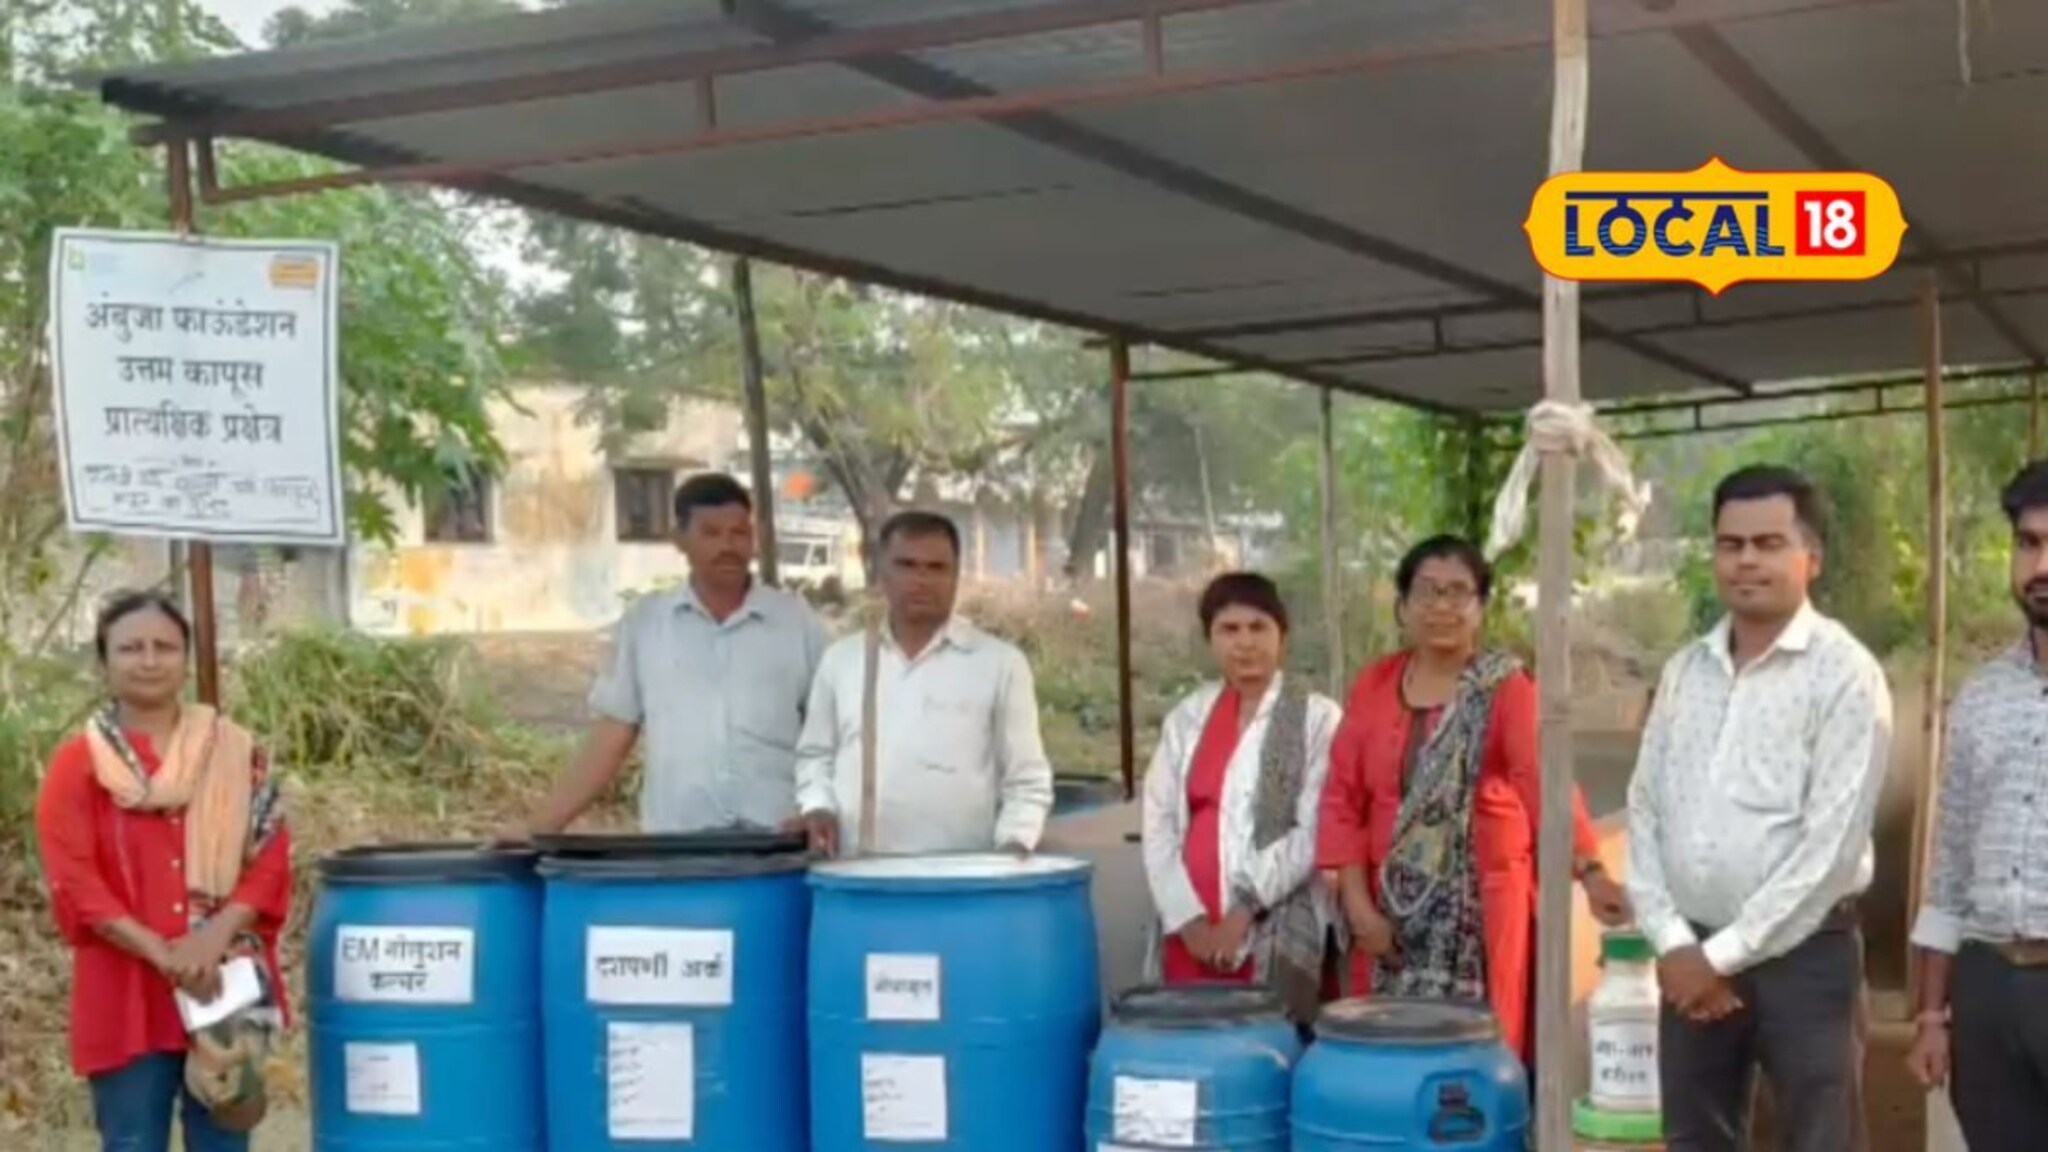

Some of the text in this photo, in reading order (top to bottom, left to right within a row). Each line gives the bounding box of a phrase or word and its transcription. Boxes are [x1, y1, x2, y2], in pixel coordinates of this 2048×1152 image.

[85, 290, 298, 343] अंबुजा फाऊंडेशन
[117, 355, 265, 400] उत्तम कापूस
[103, 400, 212, 440] प्रात्यक्षिक
